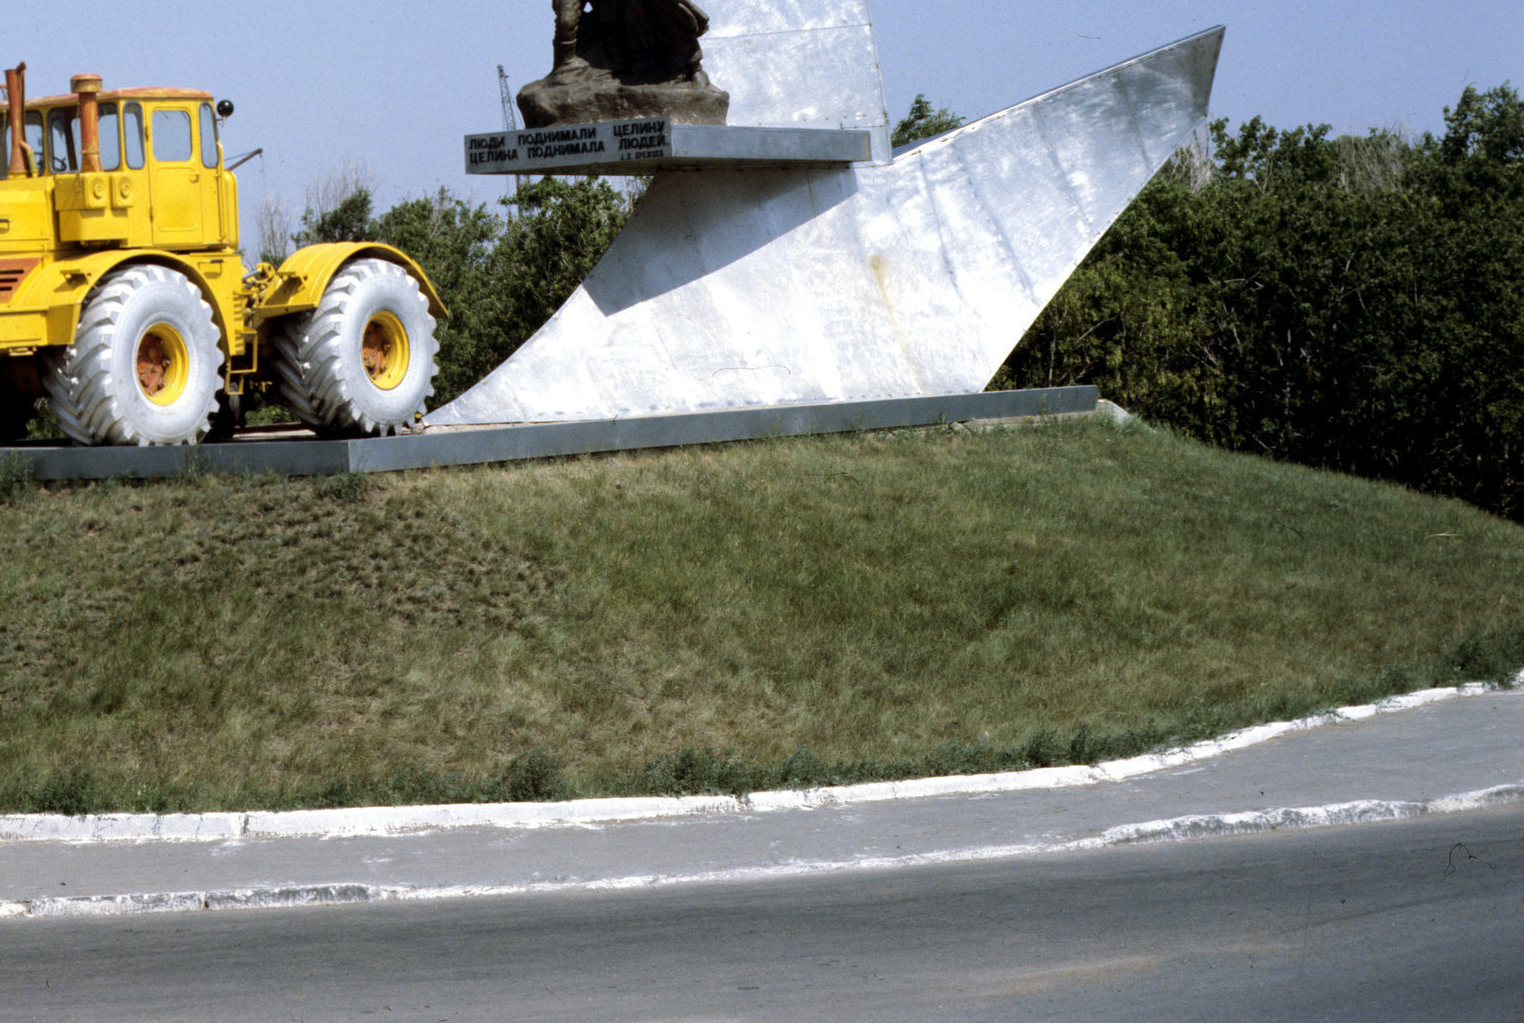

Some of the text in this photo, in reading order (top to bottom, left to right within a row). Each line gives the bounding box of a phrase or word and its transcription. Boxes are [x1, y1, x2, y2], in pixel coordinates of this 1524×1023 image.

[469, 121, 666, 150] ЛЮДИ ПОДНИМАЛИ ЦЕЛИНУ
[469, 148, 518, 164] ЦЕЛИНА
[527, 140, 605, 159] ПОДНИМАЛА
